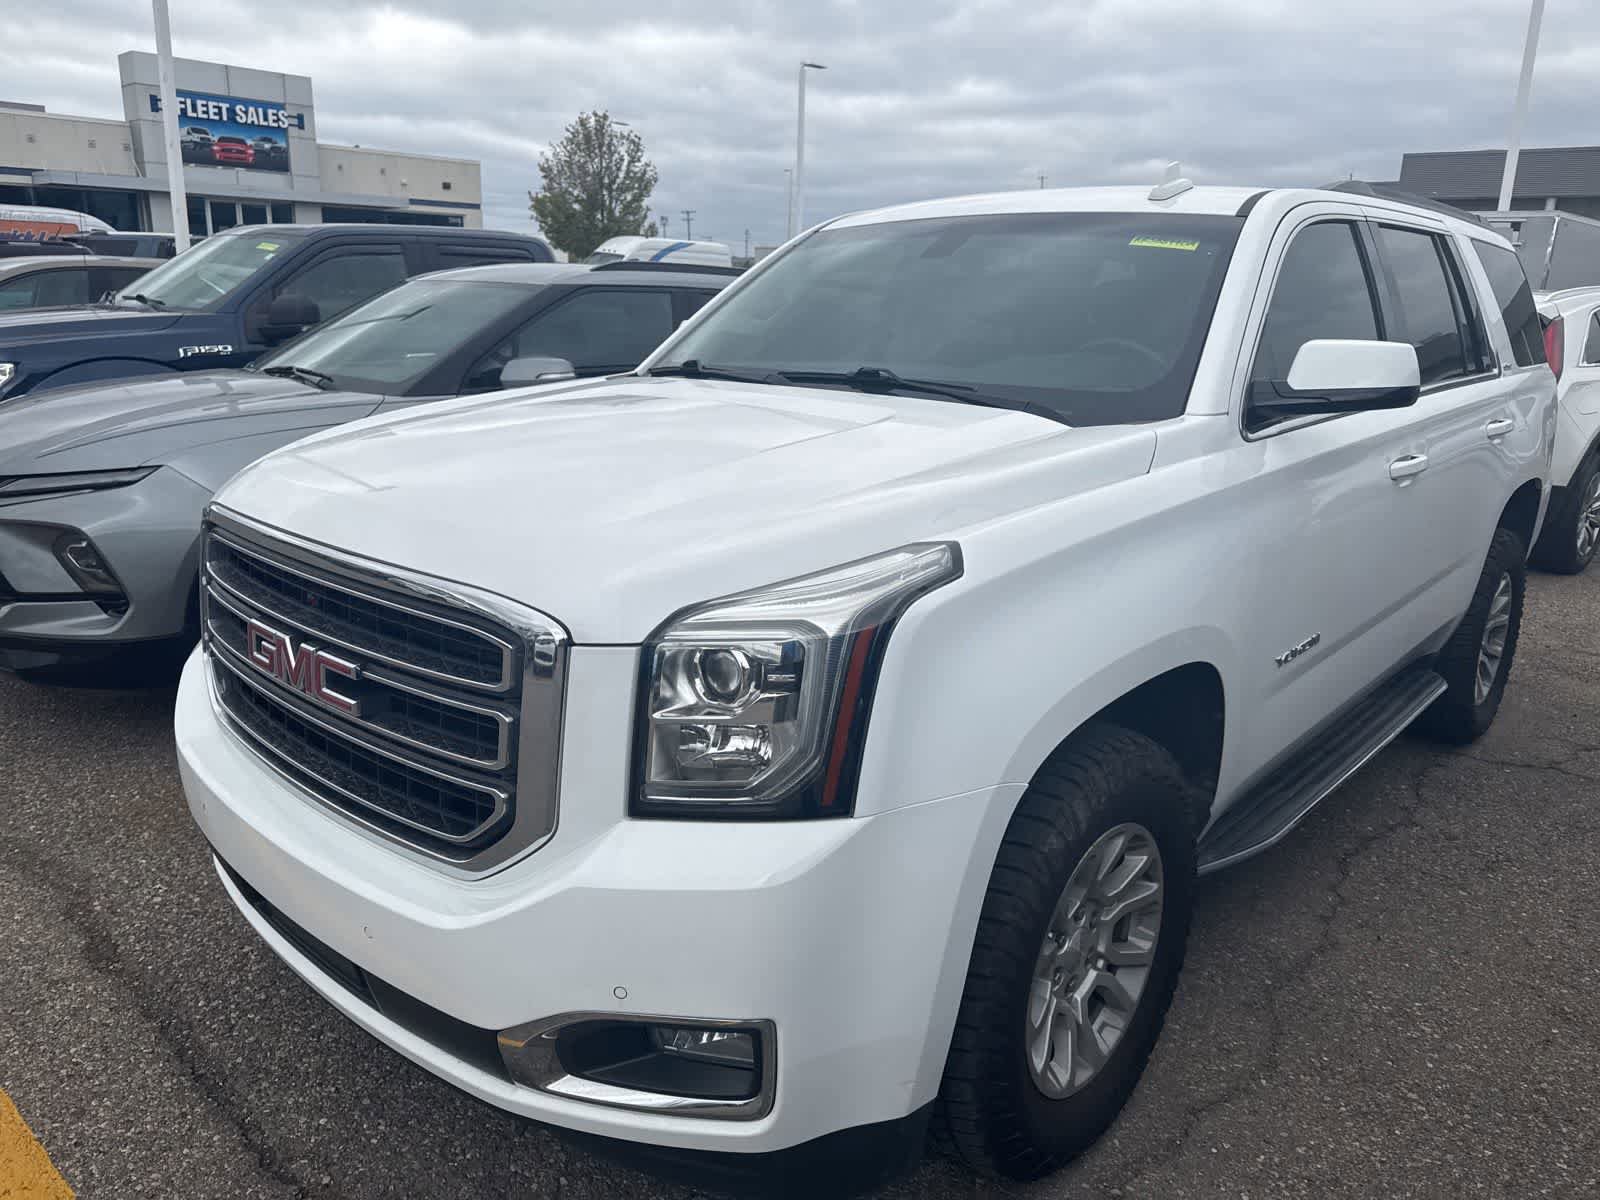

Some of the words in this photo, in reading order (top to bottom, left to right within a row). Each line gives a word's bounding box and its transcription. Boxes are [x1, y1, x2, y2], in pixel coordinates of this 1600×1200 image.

[176, 97, 230, 121] FLEET
[235, 103, 289, 129] SALES
[247, 618, 361, 717] GMC
